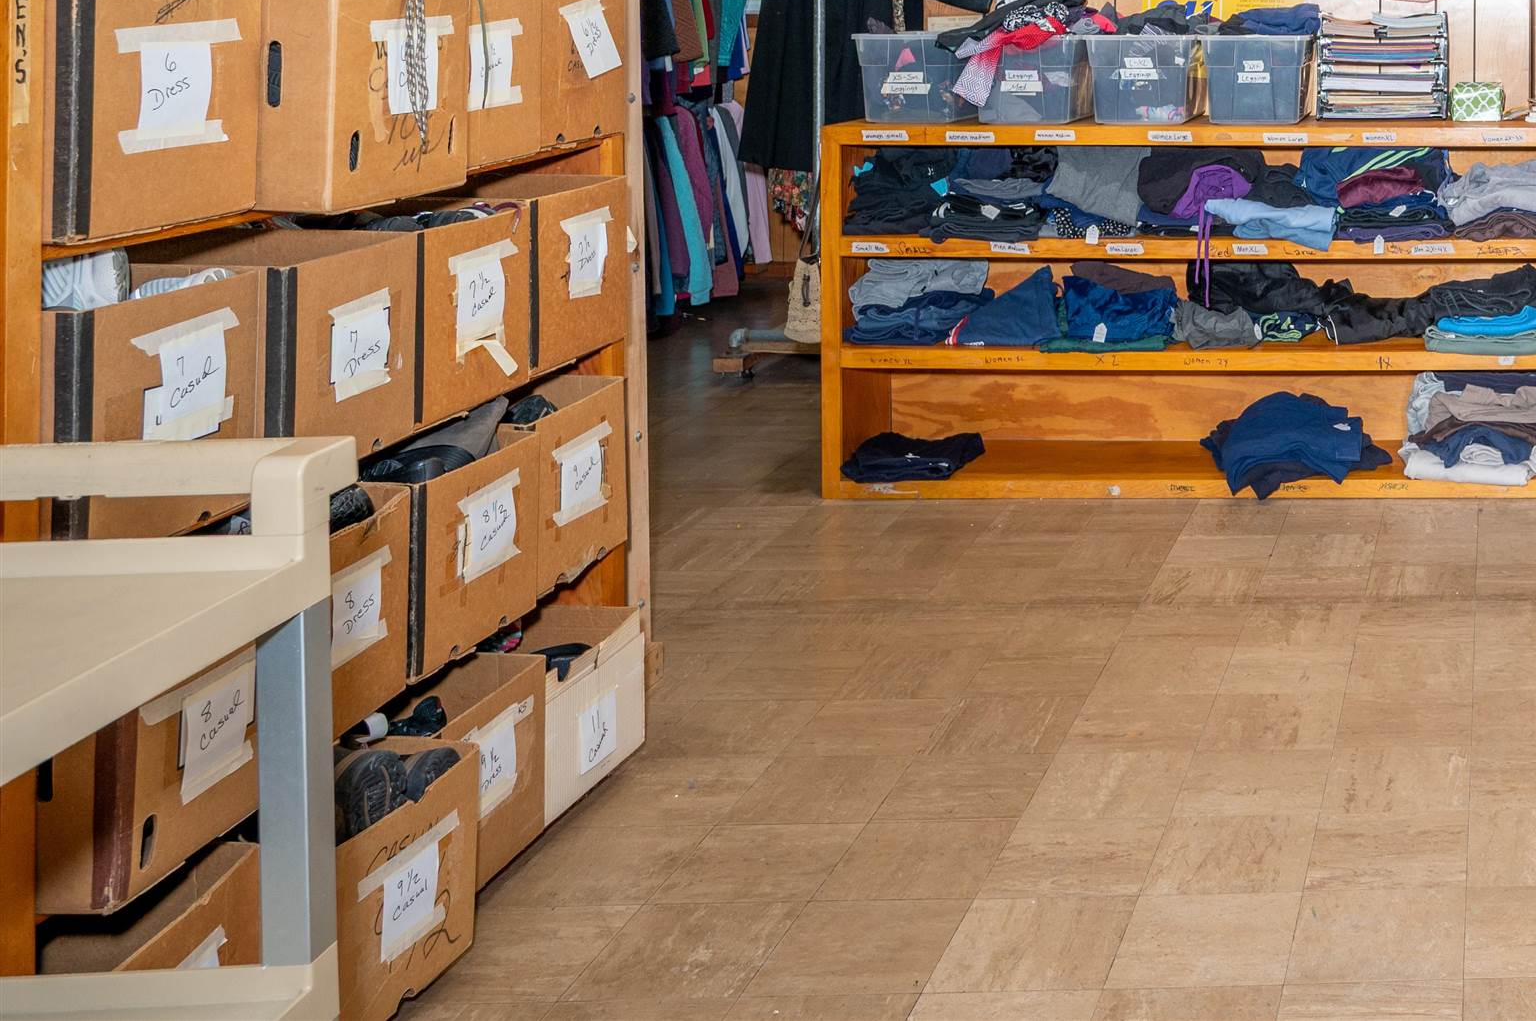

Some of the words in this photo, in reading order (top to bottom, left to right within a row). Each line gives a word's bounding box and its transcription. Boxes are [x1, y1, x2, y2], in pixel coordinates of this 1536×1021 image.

[164, 52, 178, 72] 6
[147, 76, 191, 111] Dress
[350, 330, 359, 353] 7
[176, 356, 185, 376] 7
[343, 339, 381, 379] Dress
[170, 356, 221, 408] Casual
[342, 593, 376, 634] Dress
[344, 590, 355, 610] 8
[200, 700, 212, 723] 8
[200, 689, 245, 752] Casual
